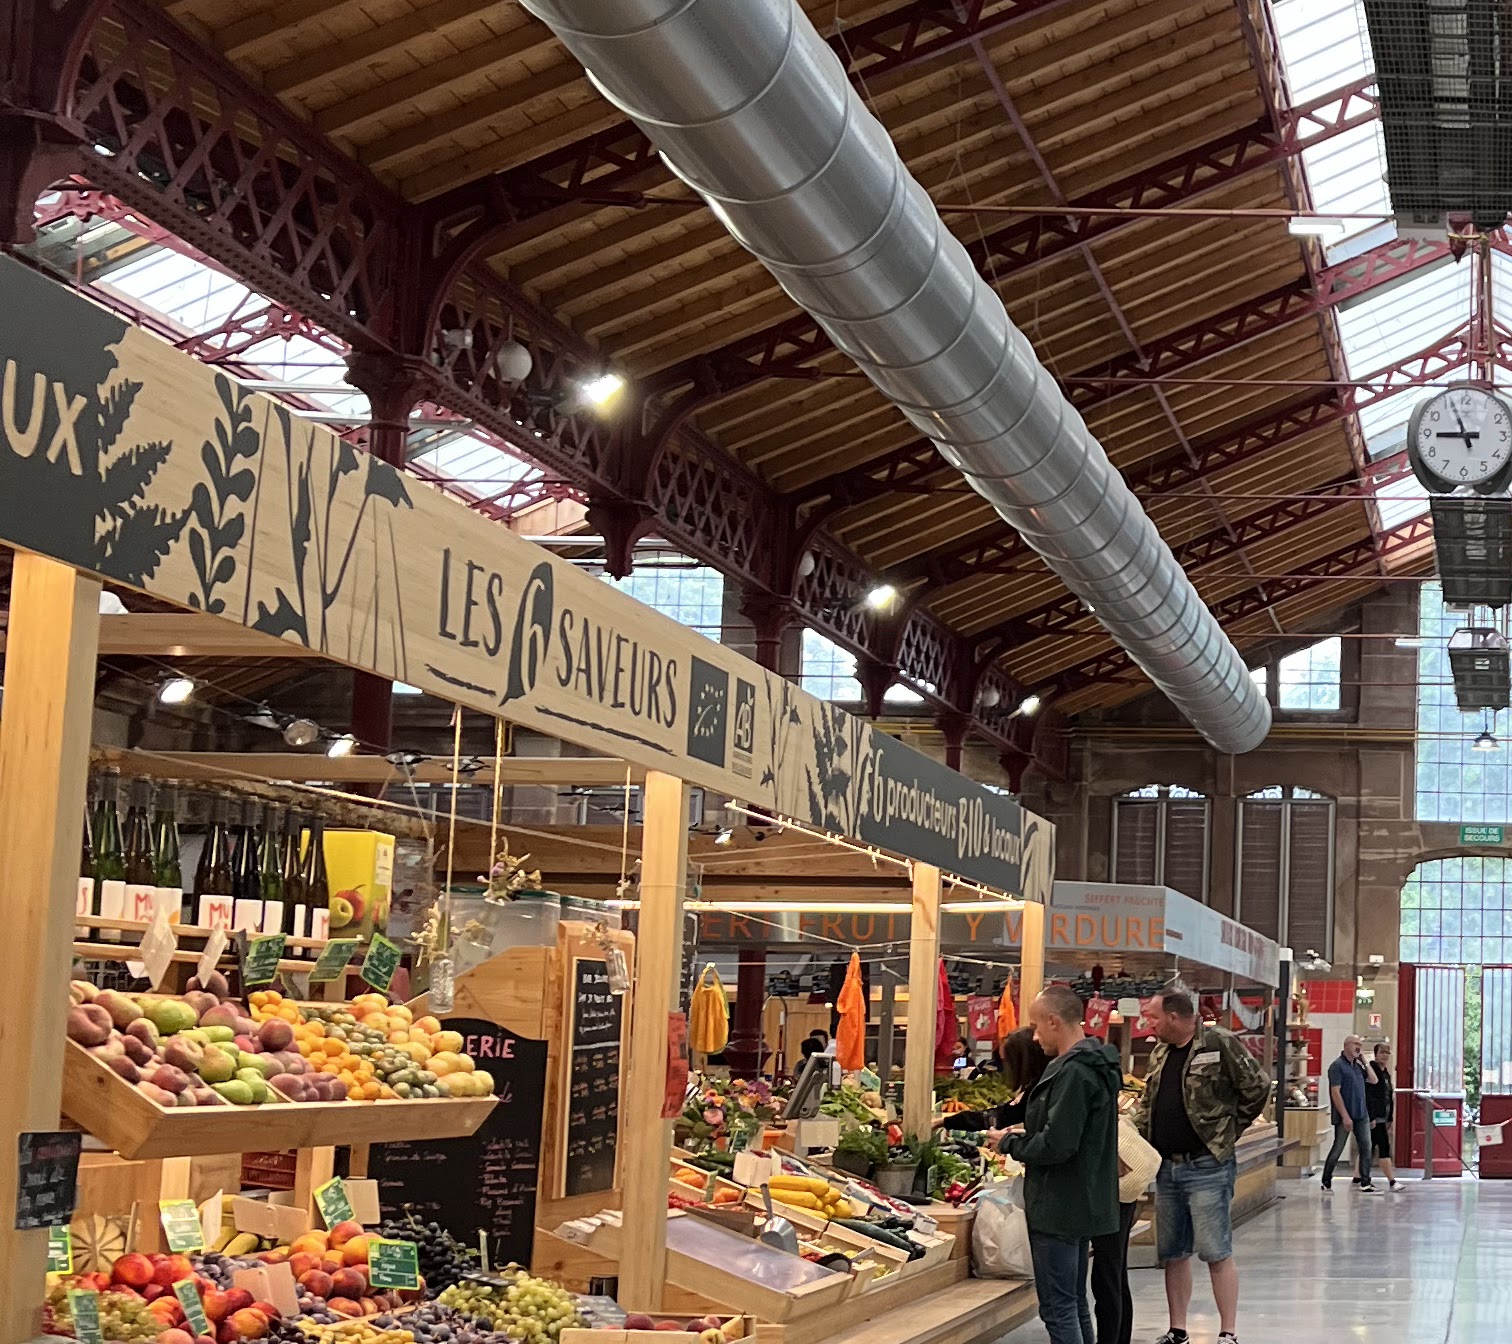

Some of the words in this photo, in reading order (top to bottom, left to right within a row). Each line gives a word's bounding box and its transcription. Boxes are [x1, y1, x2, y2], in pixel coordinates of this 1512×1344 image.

[1430, 411, 1440, 422] 10
[1494, 414, 1503, 424] 2
[1424, 429, 1432, 439] 9
[1499, 431, 1507, 442] 3
[1429, 447, 1436, 457] 8
[1492, 449, 1500, 459] 4
[1442, 460, 1450, 471] 7
[1480, 461, 1488, 472] 5
[1460, 467, 1468, 477] 6
[438, 547, 504, 657] LES
[556, 608, 677, 729] SAVEURS
[873, 748, 884, 823] 6
[885, 778, 956, 839] producteurs
[958, 796, 983, 859] BIO
[1005, 911, 1165, 949] VRDURE
[467, 1035, 517, 1060] ERIE
